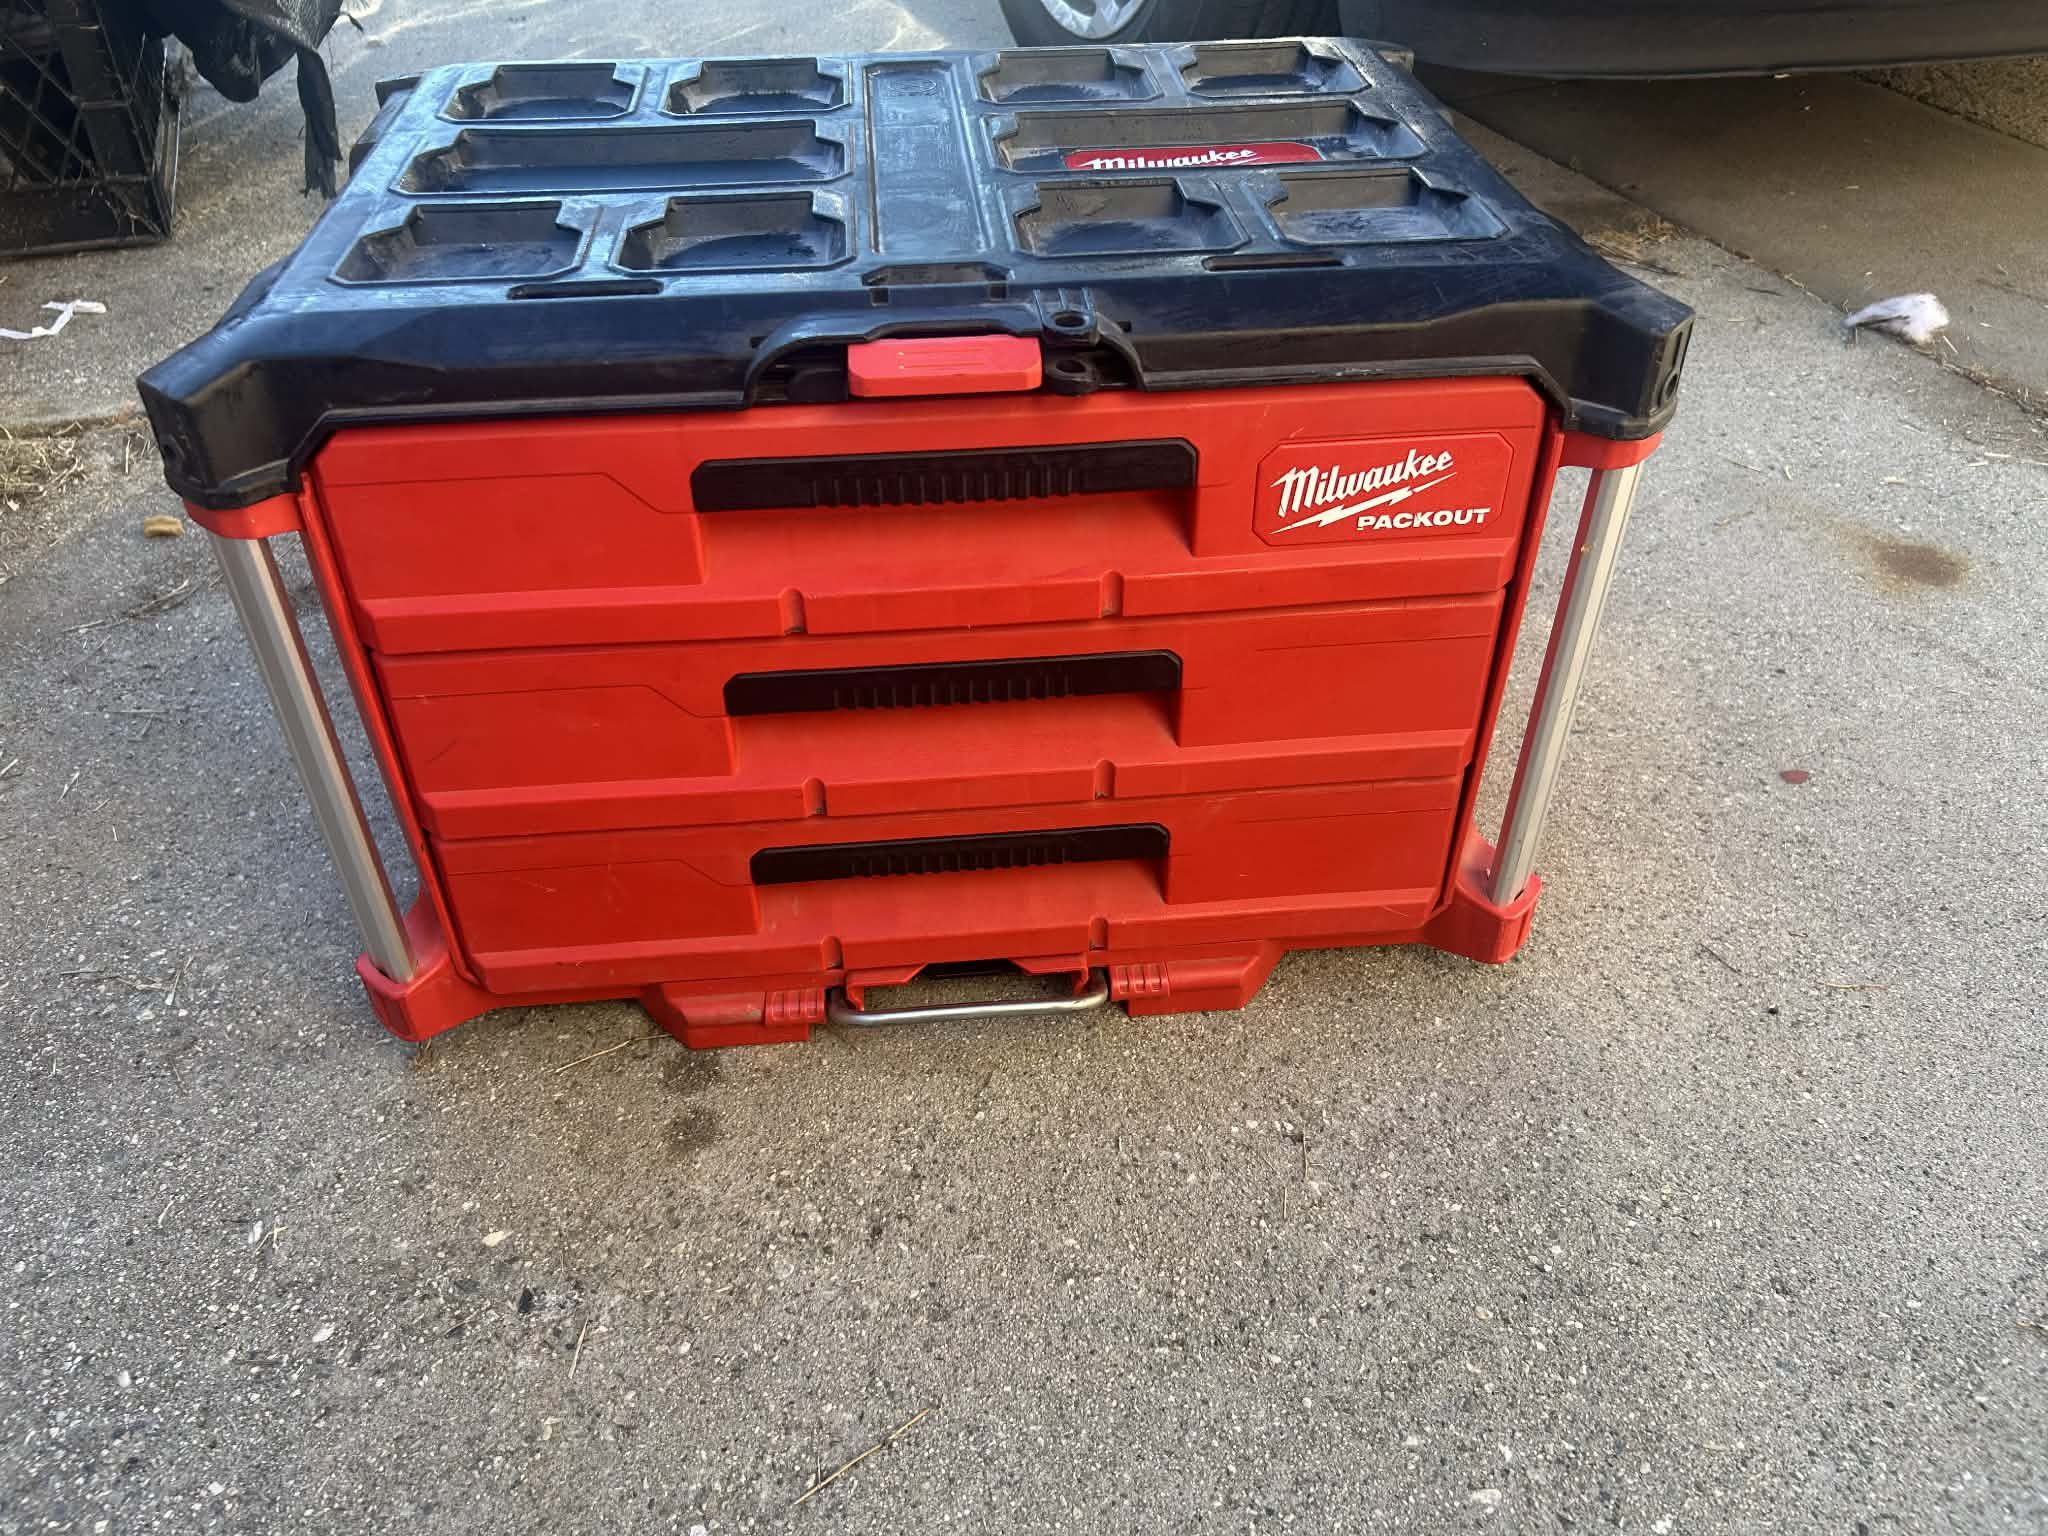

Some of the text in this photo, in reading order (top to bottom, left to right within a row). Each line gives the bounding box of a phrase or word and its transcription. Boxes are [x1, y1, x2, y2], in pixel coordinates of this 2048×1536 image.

[1079, 149, 1257, 169] Milwaukee
[1270, 449, 1454, 518] Milwaukee
[1356, 508, 1491, 531] PACKOUT
